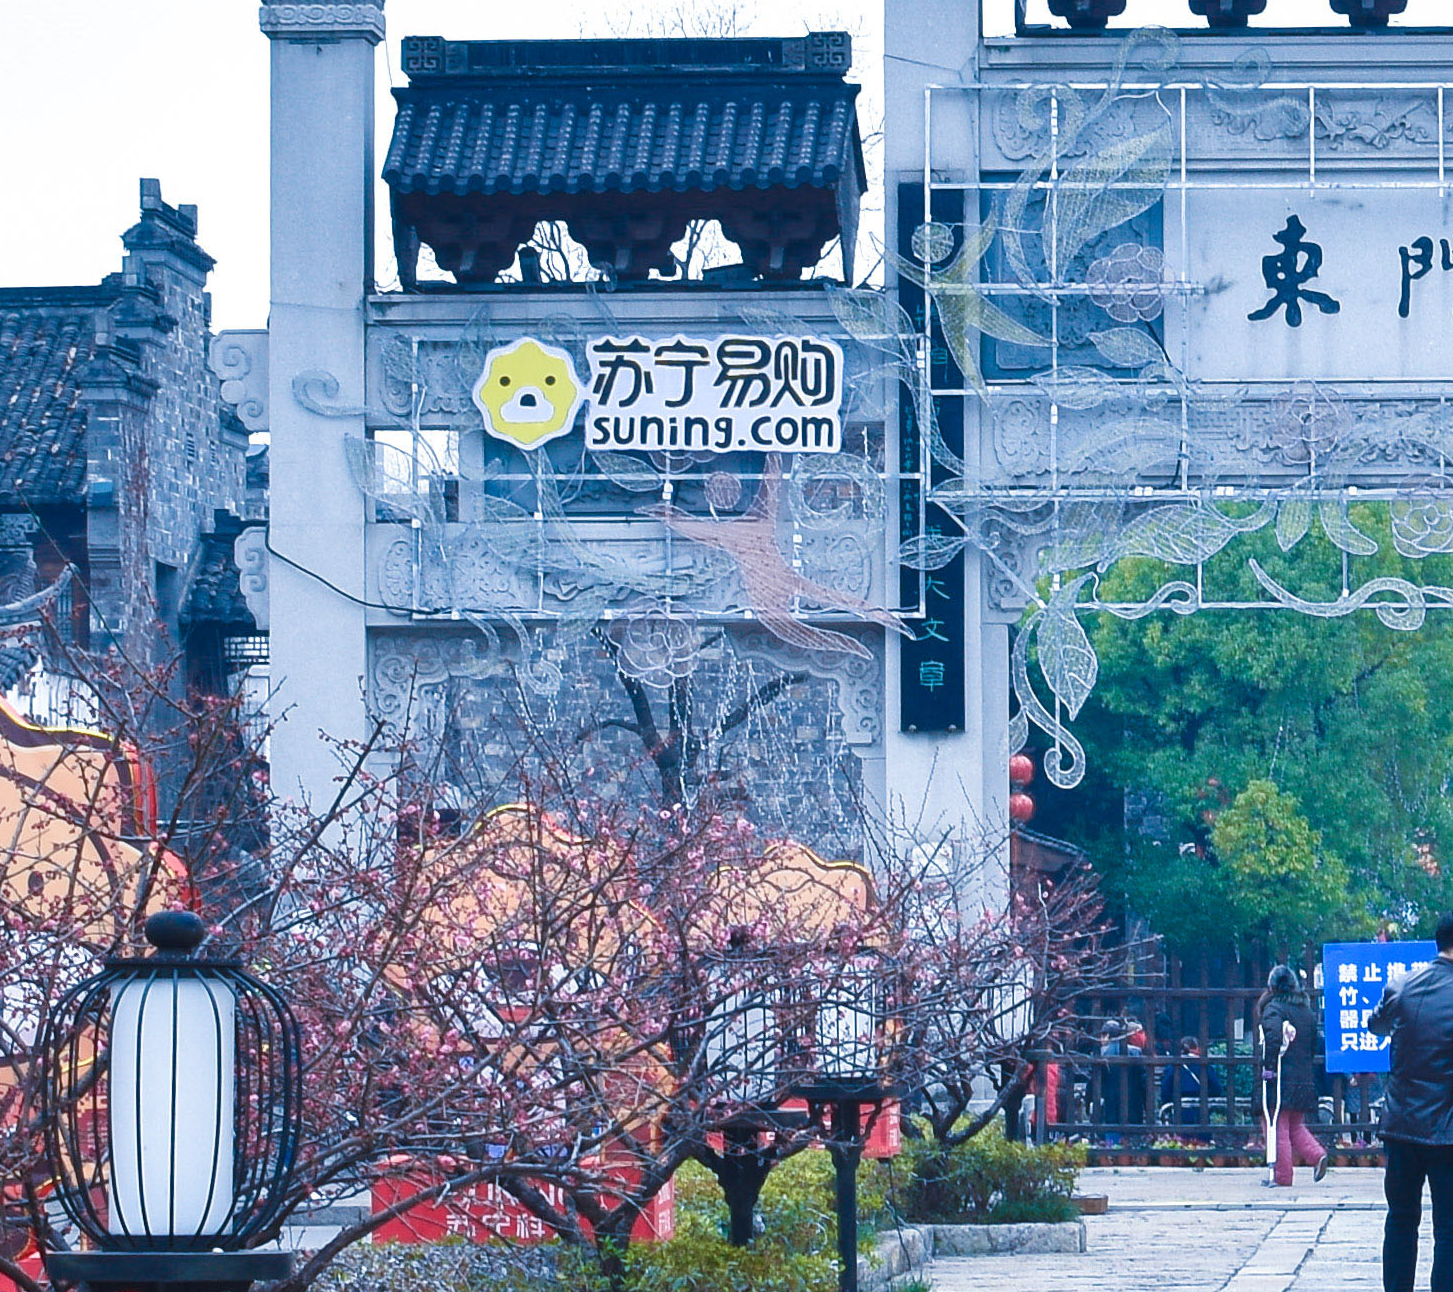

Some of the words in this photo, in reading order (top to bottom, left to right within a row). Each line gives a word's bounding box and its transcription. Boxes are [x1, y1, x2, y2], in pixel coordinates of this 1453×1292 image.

[592, 338, 836, 408] 苏宁易购
[592, 416, 834, 448] suning.com
